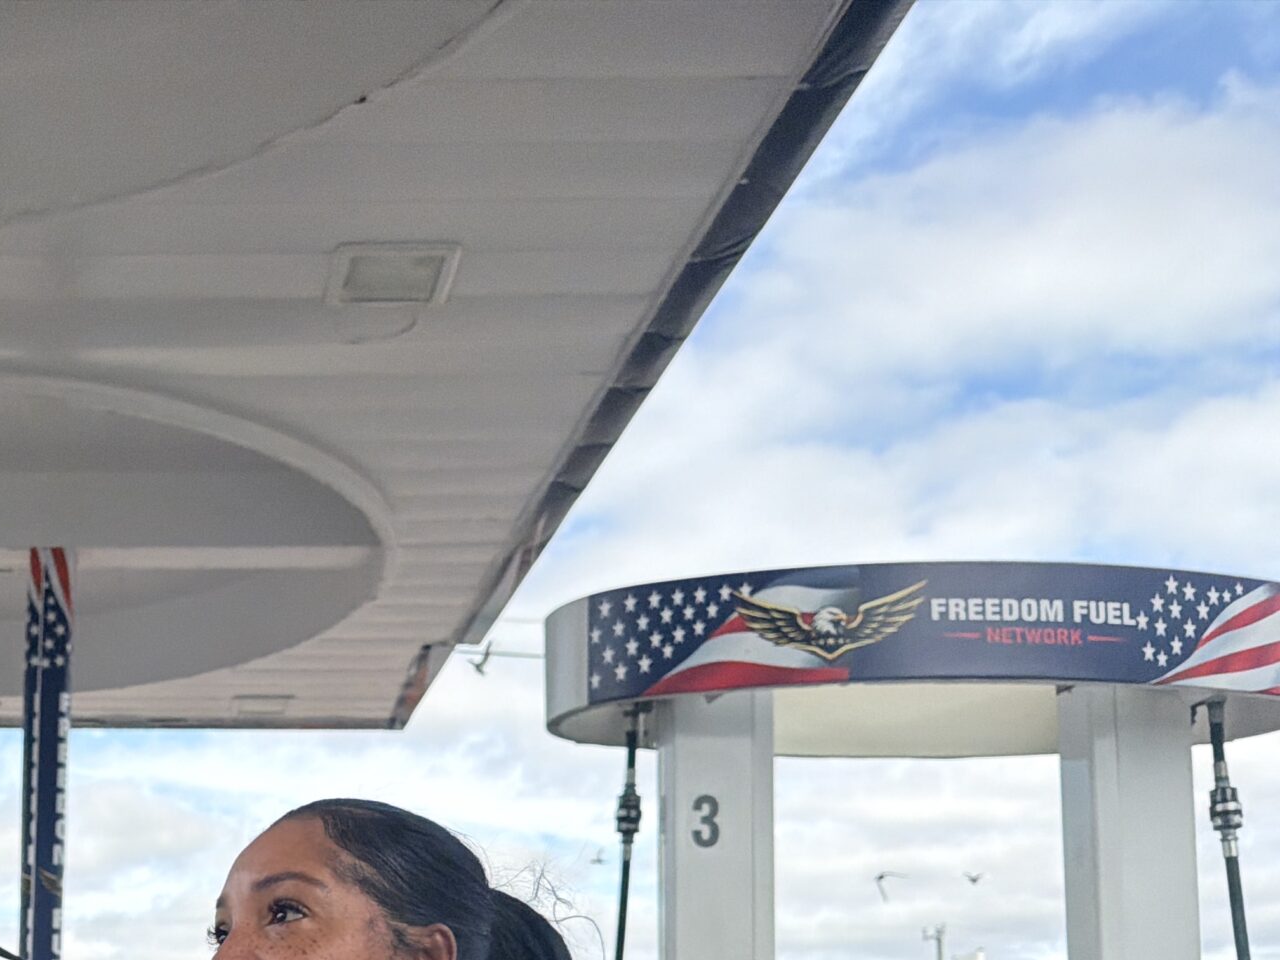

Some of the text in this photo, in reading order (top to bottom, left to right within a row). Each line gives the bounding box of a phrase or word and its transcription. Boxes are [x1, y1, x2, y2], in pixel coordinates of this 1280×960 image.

[931, 597, 1137, 627] FREEDOM FUEL
[987, 628, 1083, 646] NETWORK
[691, 795, 721, 848] 3
